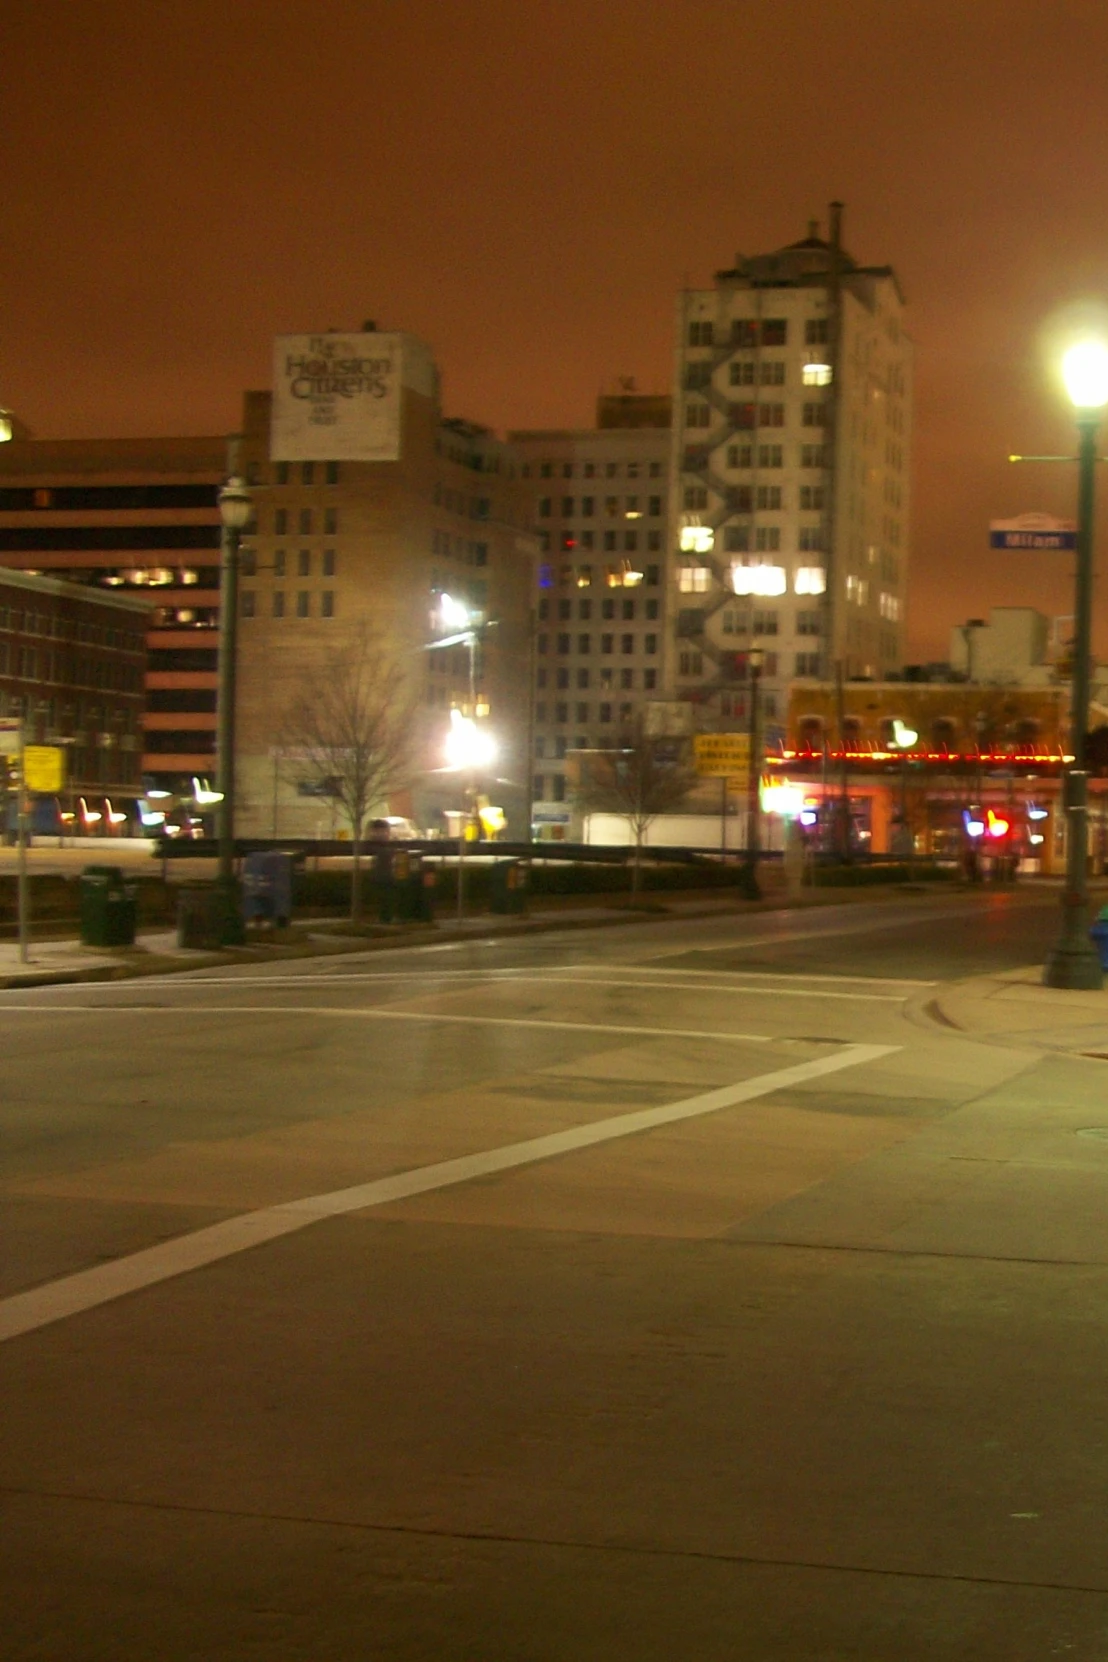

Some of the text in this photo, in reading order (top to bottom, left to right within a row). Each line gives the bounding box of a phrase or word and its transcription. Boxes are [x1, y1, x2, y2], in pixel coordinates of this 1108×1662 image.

[286, 354, 391, 376] Houston
[290, 376, 387, 399] Citizens
[1005, 533, 1061, 547] Milam
